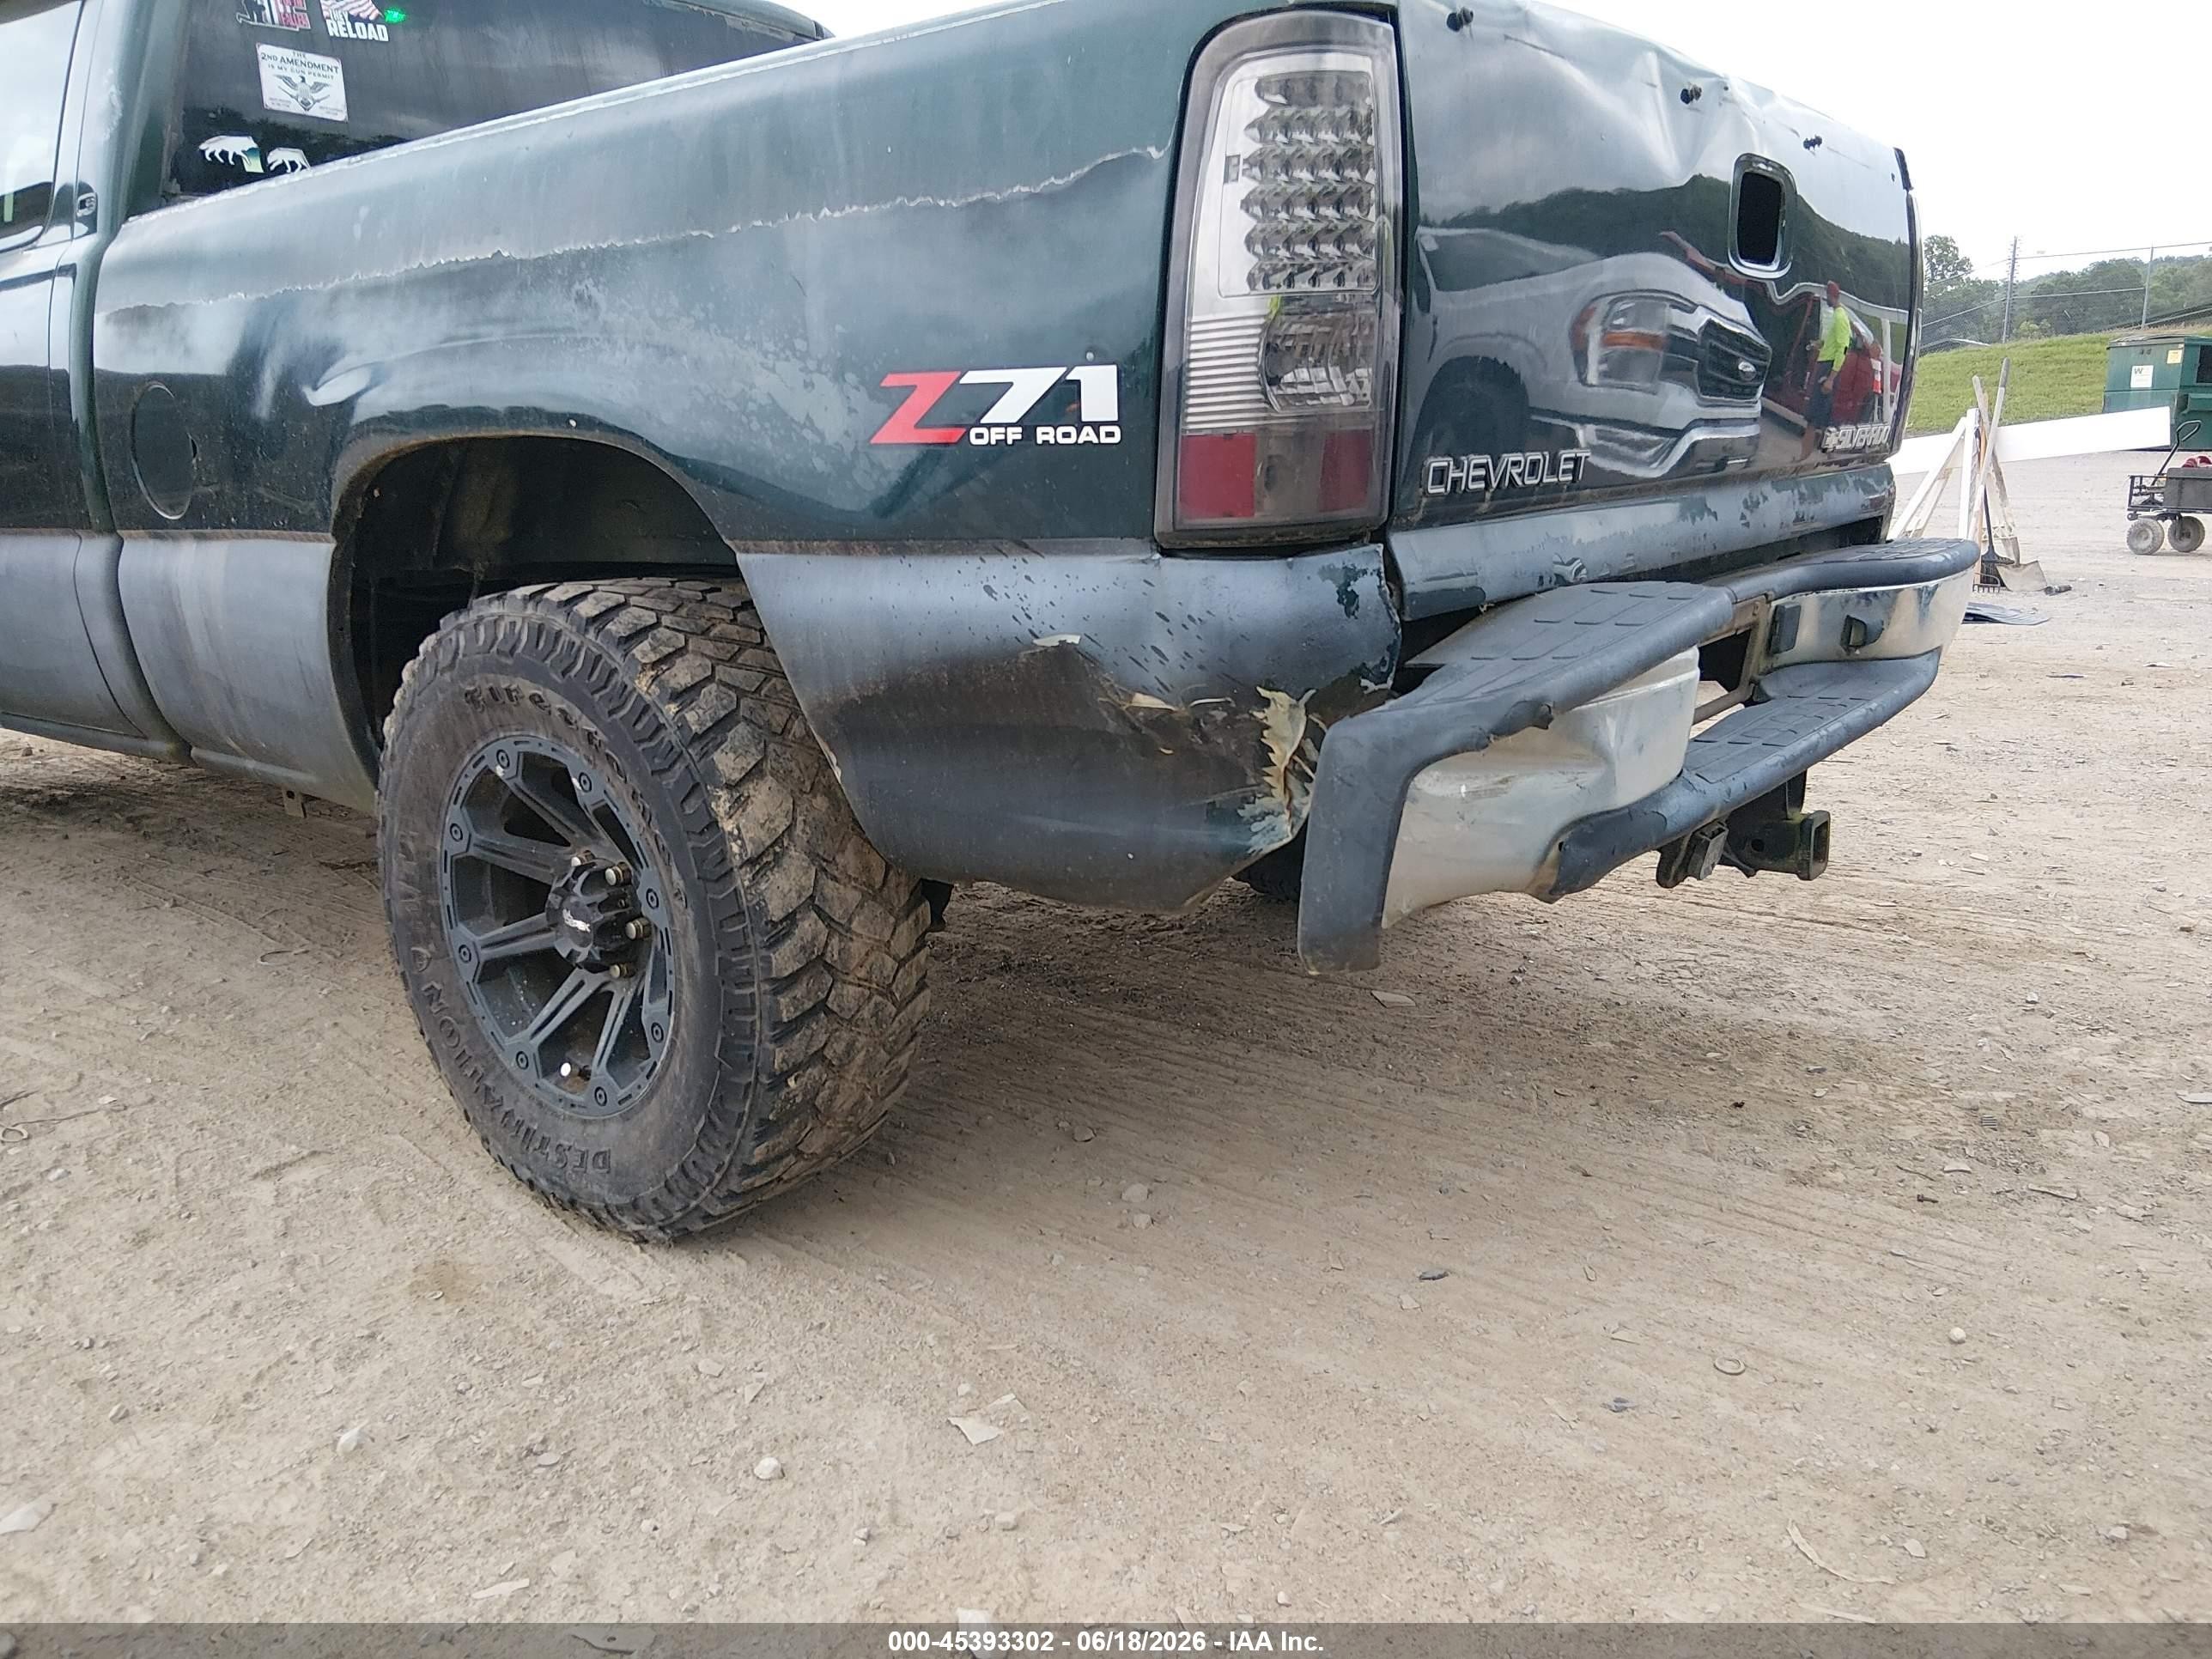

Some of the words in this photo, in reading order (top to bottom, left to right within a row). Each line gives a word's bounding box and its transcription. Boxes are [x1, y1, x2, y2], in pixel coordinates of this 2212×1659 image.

[325, 19, 389, 42] RELOAD
[260, 52, 279, 62] 2ND
[280, 56, 339, 74] AMENDMENT
[870, 364, 1118, 444] Z71
[969, 427, 1023, 445] OFF
[1036, 425, 1121, 445] ROAD
[1424, 448, 1592, 495] CHEVROLET
